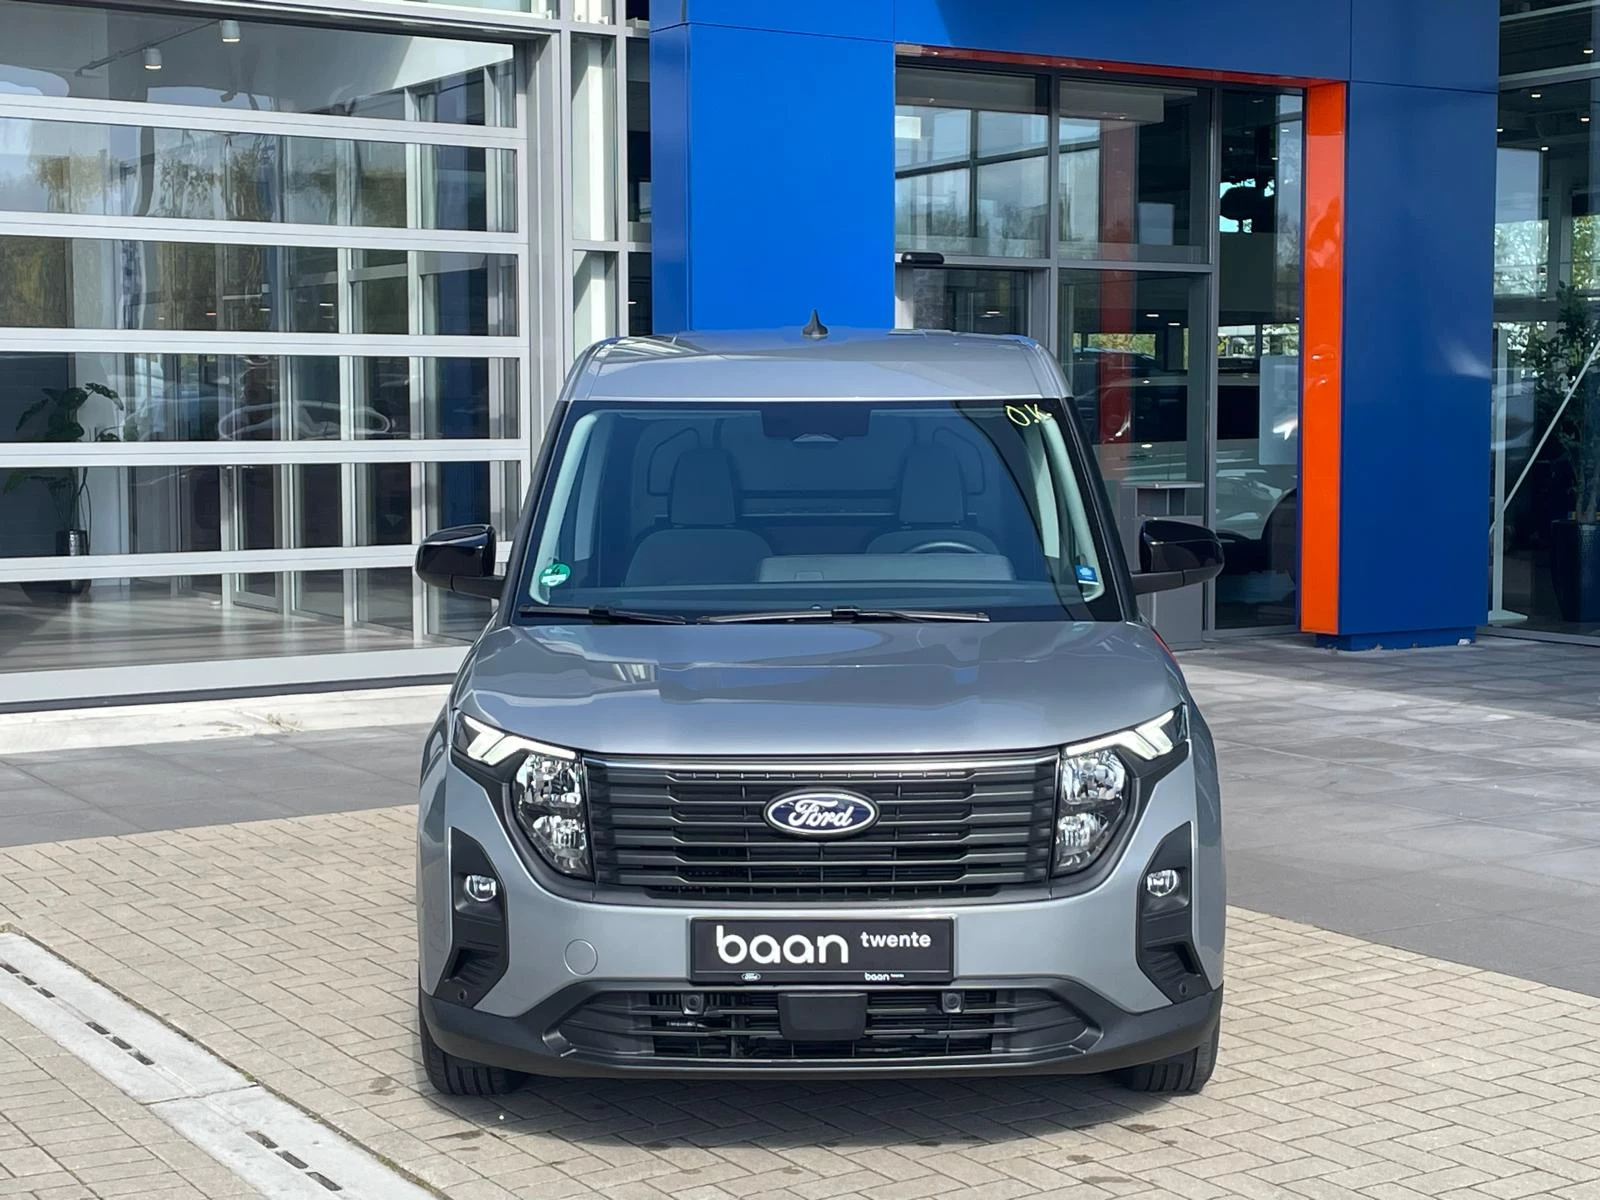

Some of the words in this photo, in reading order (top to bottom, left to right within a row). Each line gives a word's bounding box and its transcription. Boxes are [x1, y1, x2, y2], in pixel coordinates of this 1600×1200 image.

[788, 799, 854, 827] Ford
[716, 925, 849, 964] baan
[860, 931, 932, 948] twente
[864, 972, 890, 981] baan
